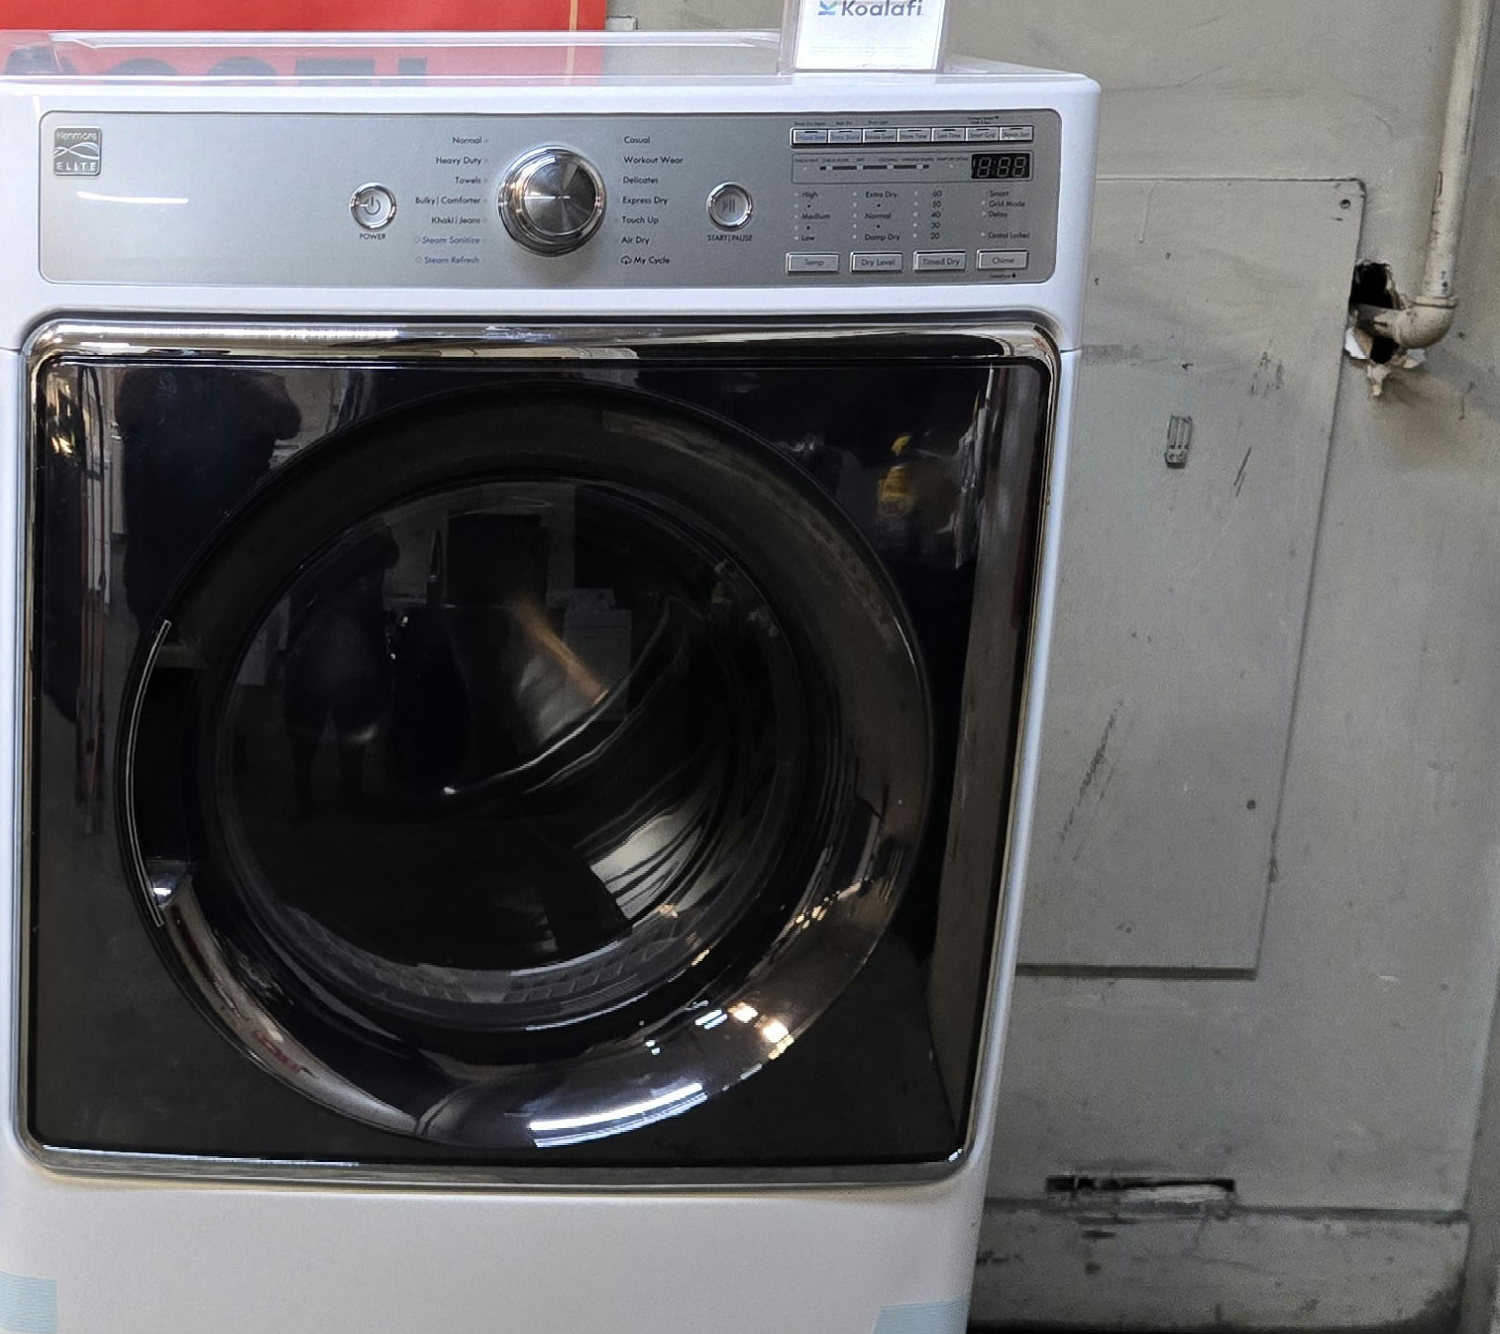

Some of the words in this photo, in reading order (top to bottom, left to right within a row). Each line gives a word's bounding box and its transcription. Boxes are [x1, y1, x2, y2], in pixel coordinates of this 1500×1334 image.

[842, 0, 923, 16] Koalafi
[624, 136, 650, 144] Casual
[436, 157, 461, 165] Heavy
[464, 157, 482, 165] Duty
[56, 162, 96, 171] ELITE
[623, 197, 651, 205] Express
[654, 197, 668, 205] Dry
[622, 216, 645, 224] Touch
[648, 216, 659, 225] Up
[636, 237, 649, 245] Dry
[634, 257, 645, 265] My
[649, 256, 670, 265] Cycle
[947, 258, 959, 266] Dry
